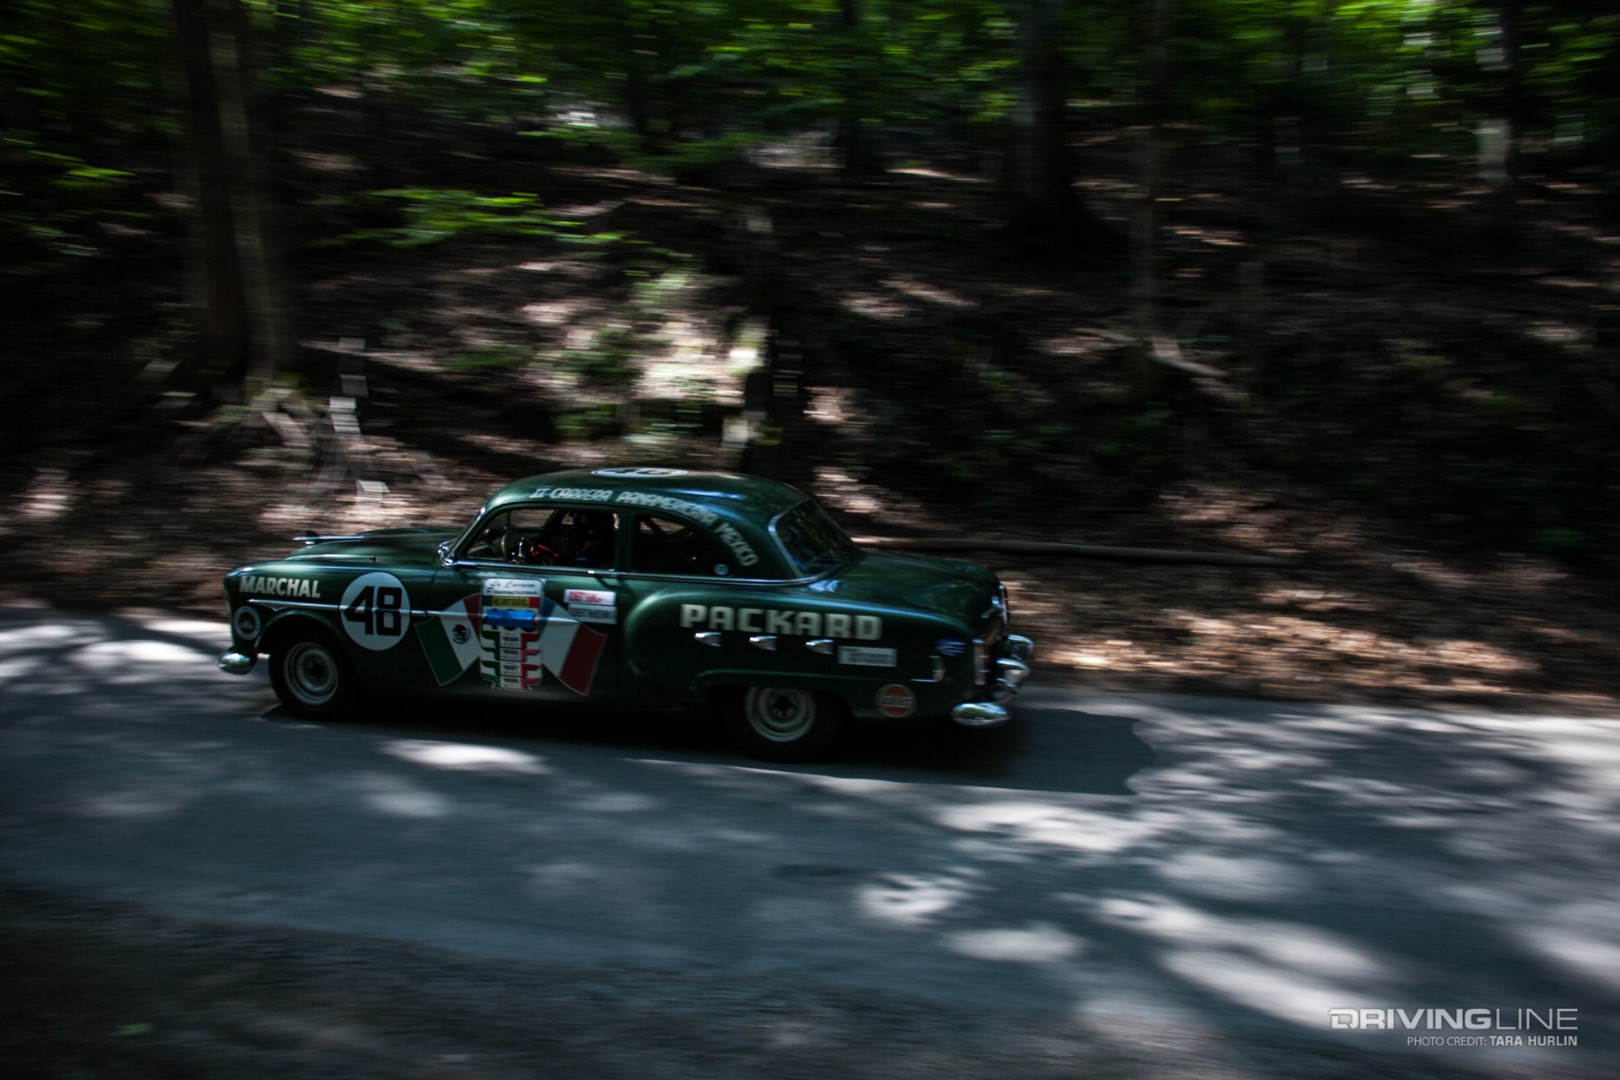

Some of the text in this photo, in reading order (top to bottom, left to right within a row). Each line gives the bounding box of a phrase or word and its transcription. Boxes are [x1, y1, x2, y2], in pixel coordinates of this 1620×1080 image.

[550, 487, 613, 502] CARRERA
[615, 491, 718, 526] PANAMERICANA
[714, 523, 760, 566] MEXICO
[239, 576, 321, 598] MARCHAL
[344, 586, 402, 636] 48
[680, 604, 883, 640] PACKARD
